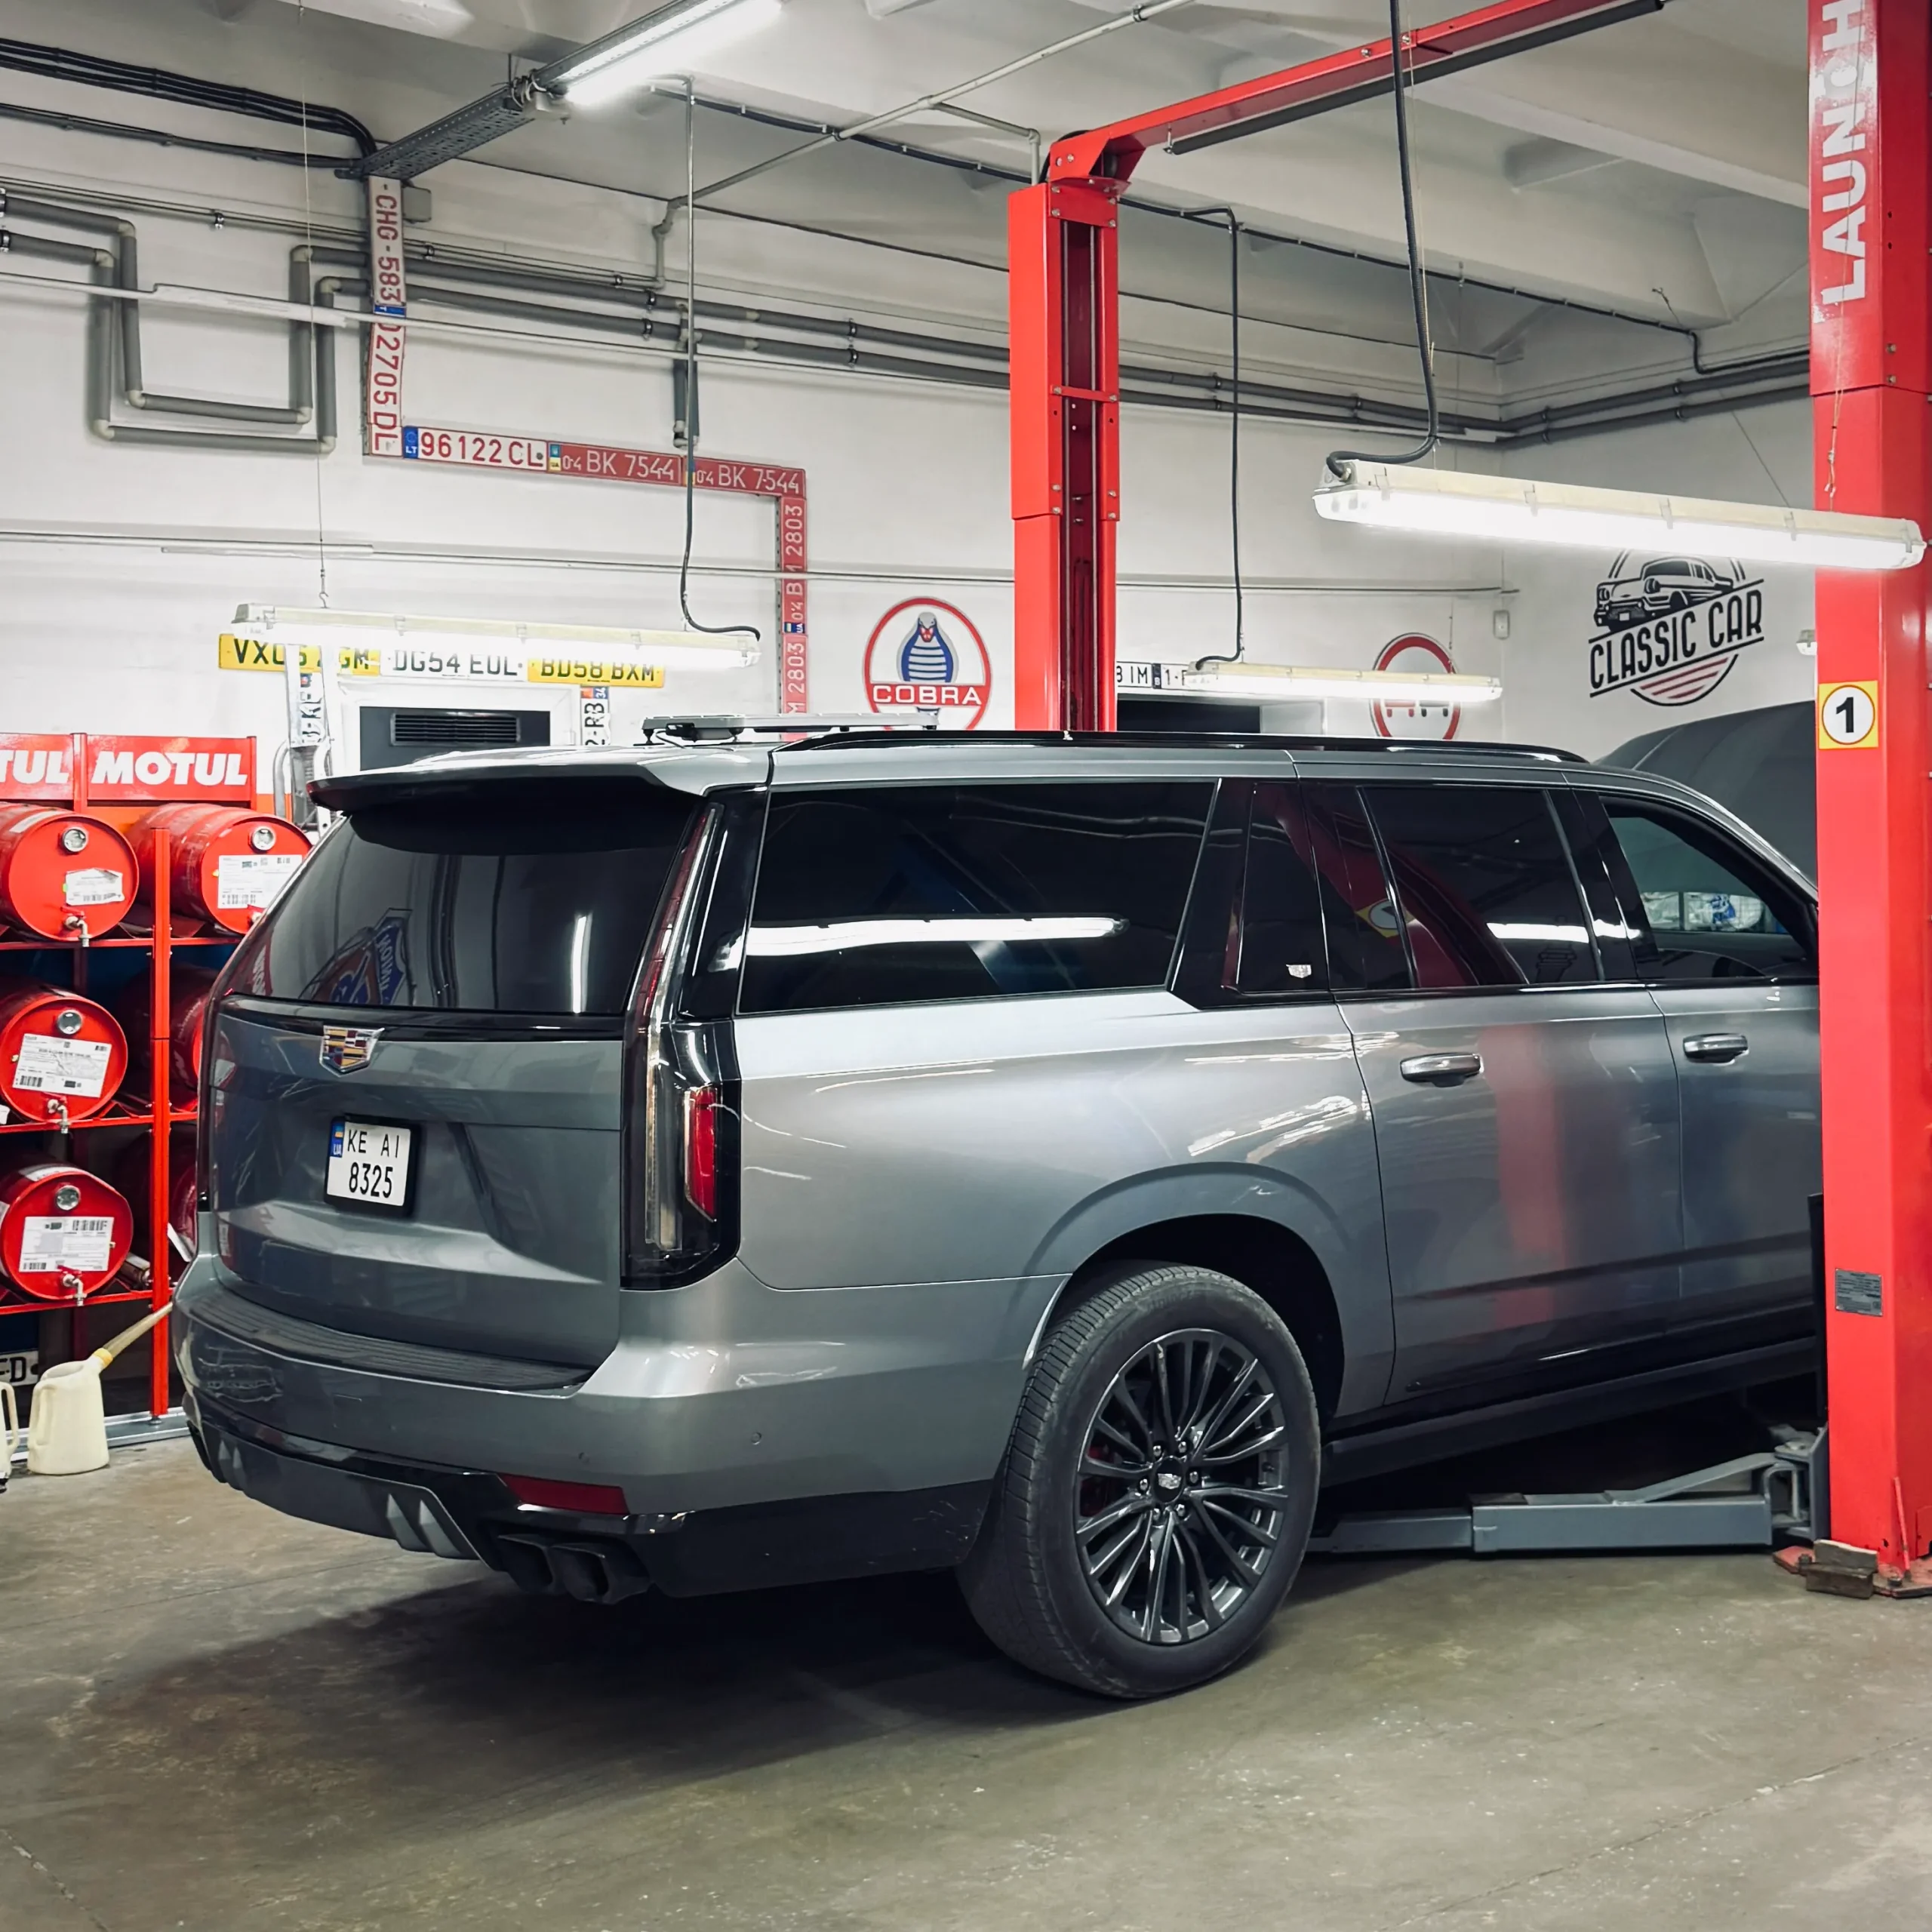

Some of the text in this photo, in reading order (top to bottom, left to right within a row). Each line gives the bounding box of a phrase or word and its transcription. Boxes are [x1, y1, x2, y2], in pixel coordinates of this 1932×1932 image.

[586, 450, 617, 475] BK
[625, 454, 674, 481] 7544
[718, 464, 746, 488] BK
[785, 505, 803, 557] 2803
[1590, 589, 1763, 690] CLASSIC CAR
[787, 642, 805, 694] 2803
[872, 685, 983, 705] COBRA
[1835, 696, 1855, 734] 1
[91, 751, 248, 786] MOTUL
[347, 1129, 368, 1154] KE
[349, 1161, 394, 1199] 8325
